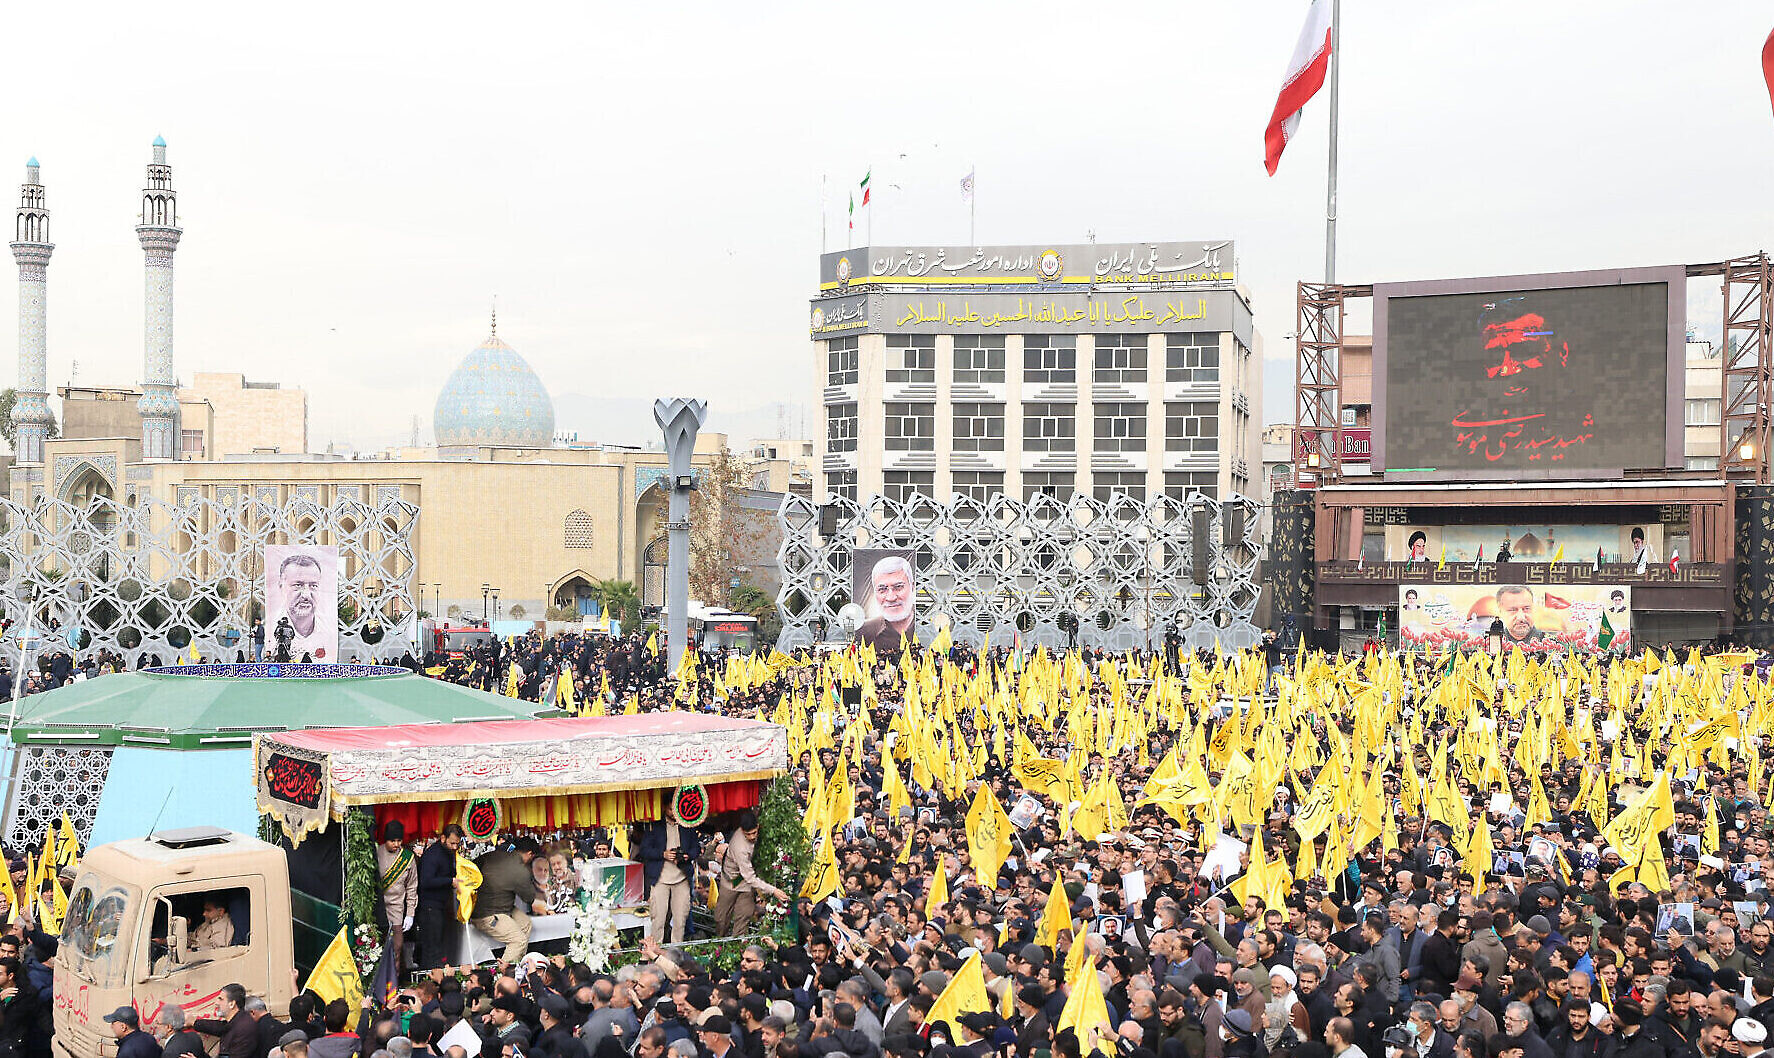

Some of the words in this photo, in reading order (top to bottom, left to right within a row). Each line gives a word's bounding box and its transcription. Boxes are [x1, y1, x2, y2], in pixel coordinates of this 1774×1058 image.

[872, 249, 914, 276] تهران
[908, 248, 946, 277] شرق
[977, 255, 1003, 271] امور
[1004, 255, 1034, 271] اداره
[1095, 248, 1135, 276] ایران
[1137, 245, 1158, 276] ملی
[1155, 241, 1231, 274] بانک
[1095, 275, 1134, 283] BANK
[896, 300, 946, 327] السلام
[947, 301, 981, 327] علیه
[981, 298, 1033, 328] الحسین
[1103, 300, 1111, 326] یا
[1156, 298, 1207, 325] السلام
[1344, 435, 1370, 454] Ban
[1525, 426, 1556, 461] سید
[1552, 413, 1594, 461] شهید
